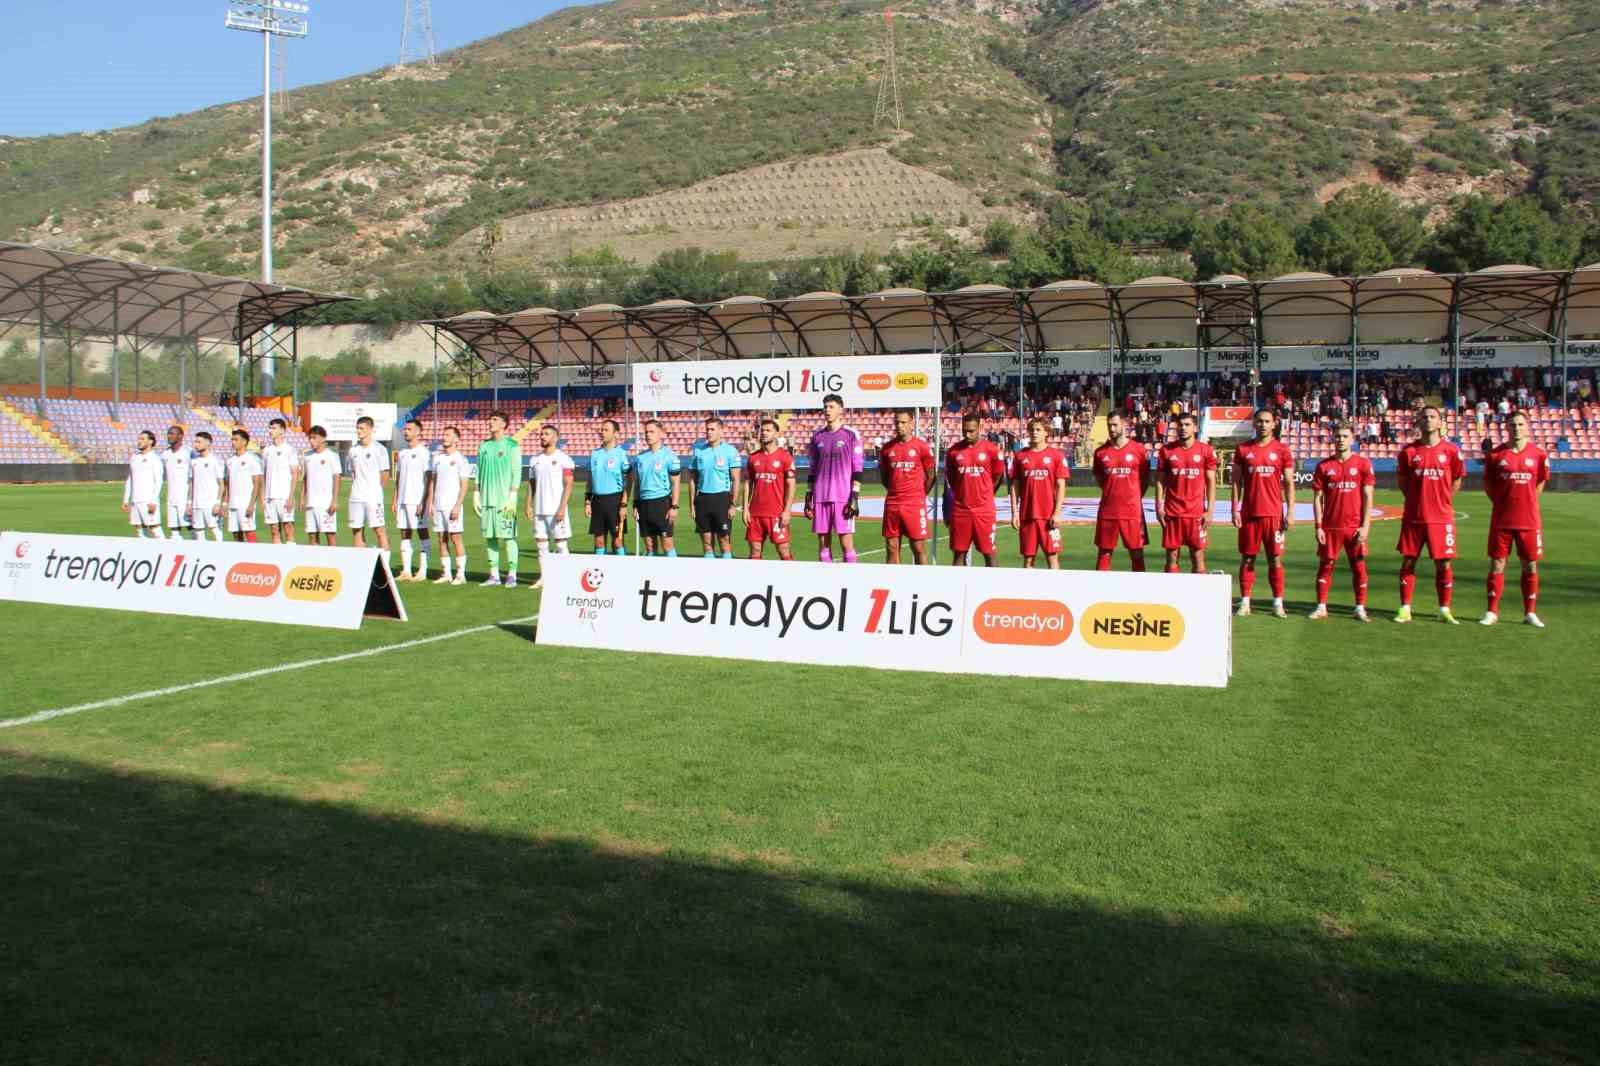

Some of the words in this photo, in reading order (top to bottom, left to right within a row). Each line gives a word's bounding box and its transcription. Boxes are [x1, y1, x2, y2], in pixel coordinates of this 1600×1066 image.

[682, 370, 790, 398] trendyol
[44, 548, 162, 589] trendyol
[231, 571, 277, 587] trendyol
[290, 574, 334, 592] NESİNE
[566, 596, 615, 610] trendyol
[638, 579, 848, 638] trendyol
[983, 610, 1065, 632] trendyol
[1093, 612, 1171, 637] NESİNE
